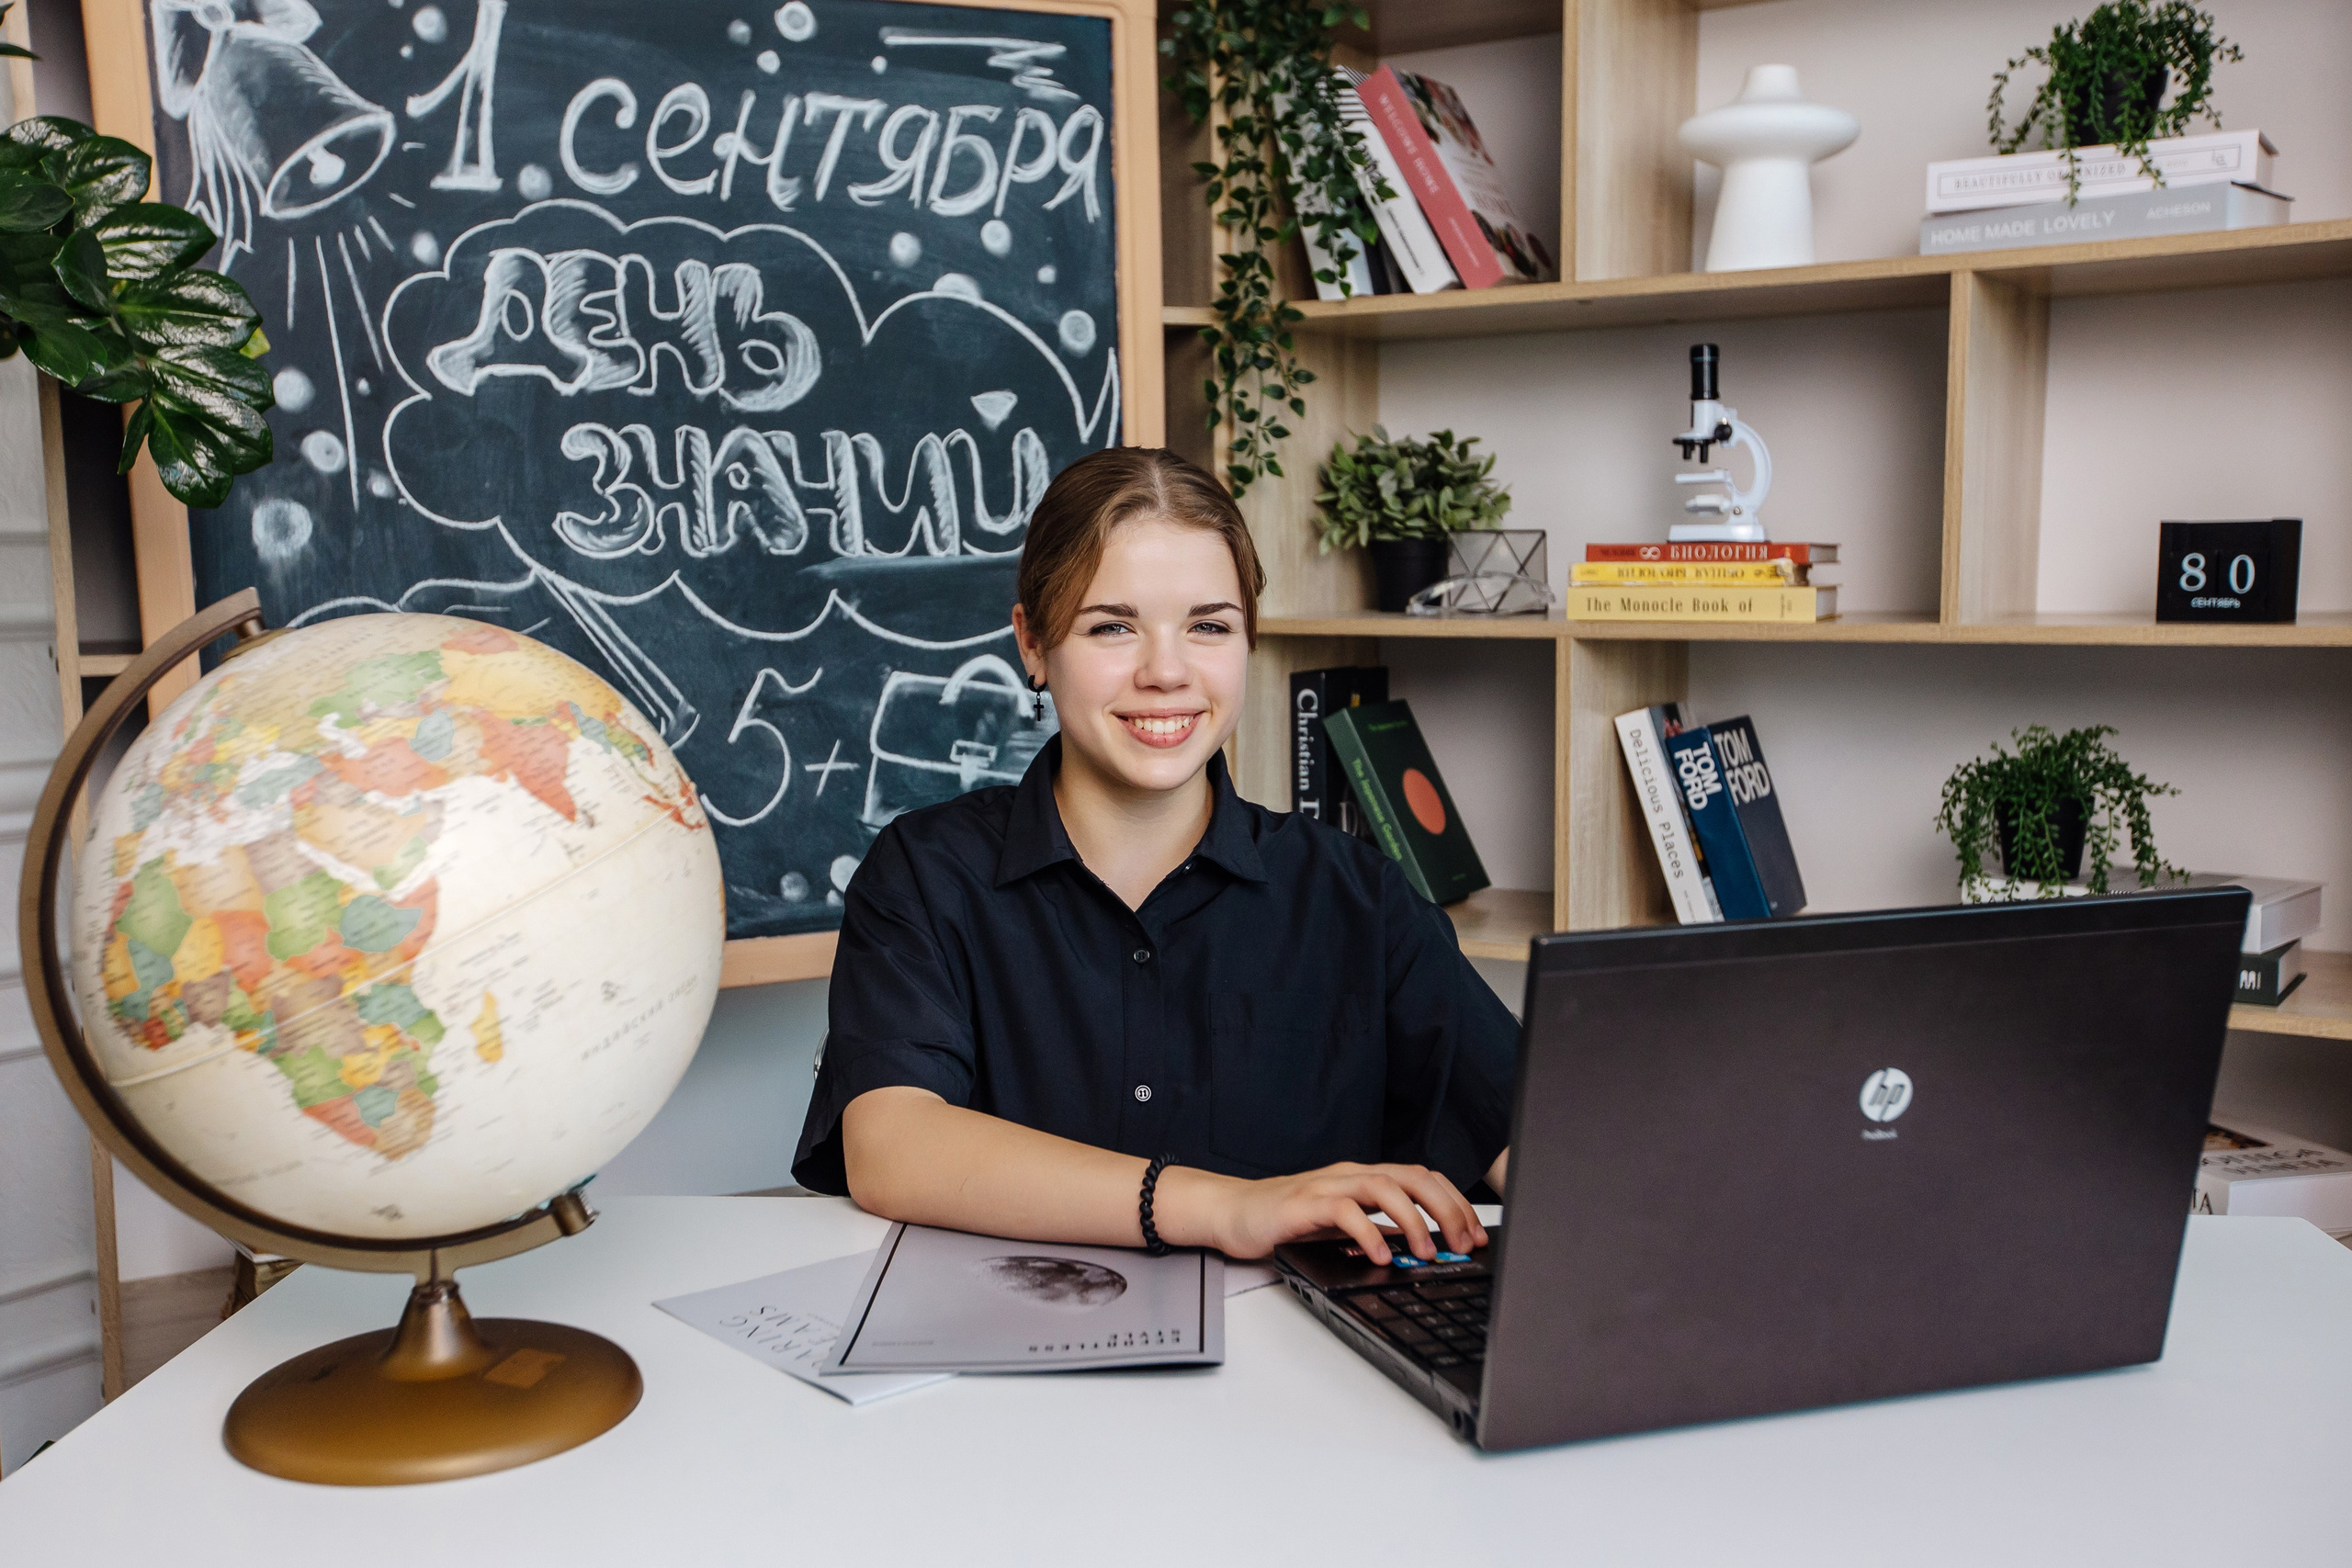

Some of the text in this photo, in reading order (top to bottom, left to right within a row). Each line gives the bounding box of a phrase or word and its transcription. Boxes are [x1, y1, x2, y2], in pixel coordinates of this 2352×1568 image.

[1413, 158, 1440, 195] HOME
[1930, 210, 2116, 246] HOME MADE LOVELY
[2145, 201, 2211, 221] ACHESON
[426, 247, 822, 412] ДЕНЬ
[1670, 545, 1769, 560] БИОЛОГИЯ
[1587, 596, 1753, 613] The Monocle Book of
[2190, 596, 2241, 609] СЕНТЯБРЬ
[1296, 689, 1318, 791] Christian
[1713, 727, 1754, 770] TOM
[1674, 747, 1708, 810] FORD
[1693, 741, 1723, 795] TOM
[1724, 761, 1771, 807] FORD
[1630, 728, 1684, 879] Delicious Places
[1860, 1066, 1914, 1122] hp
